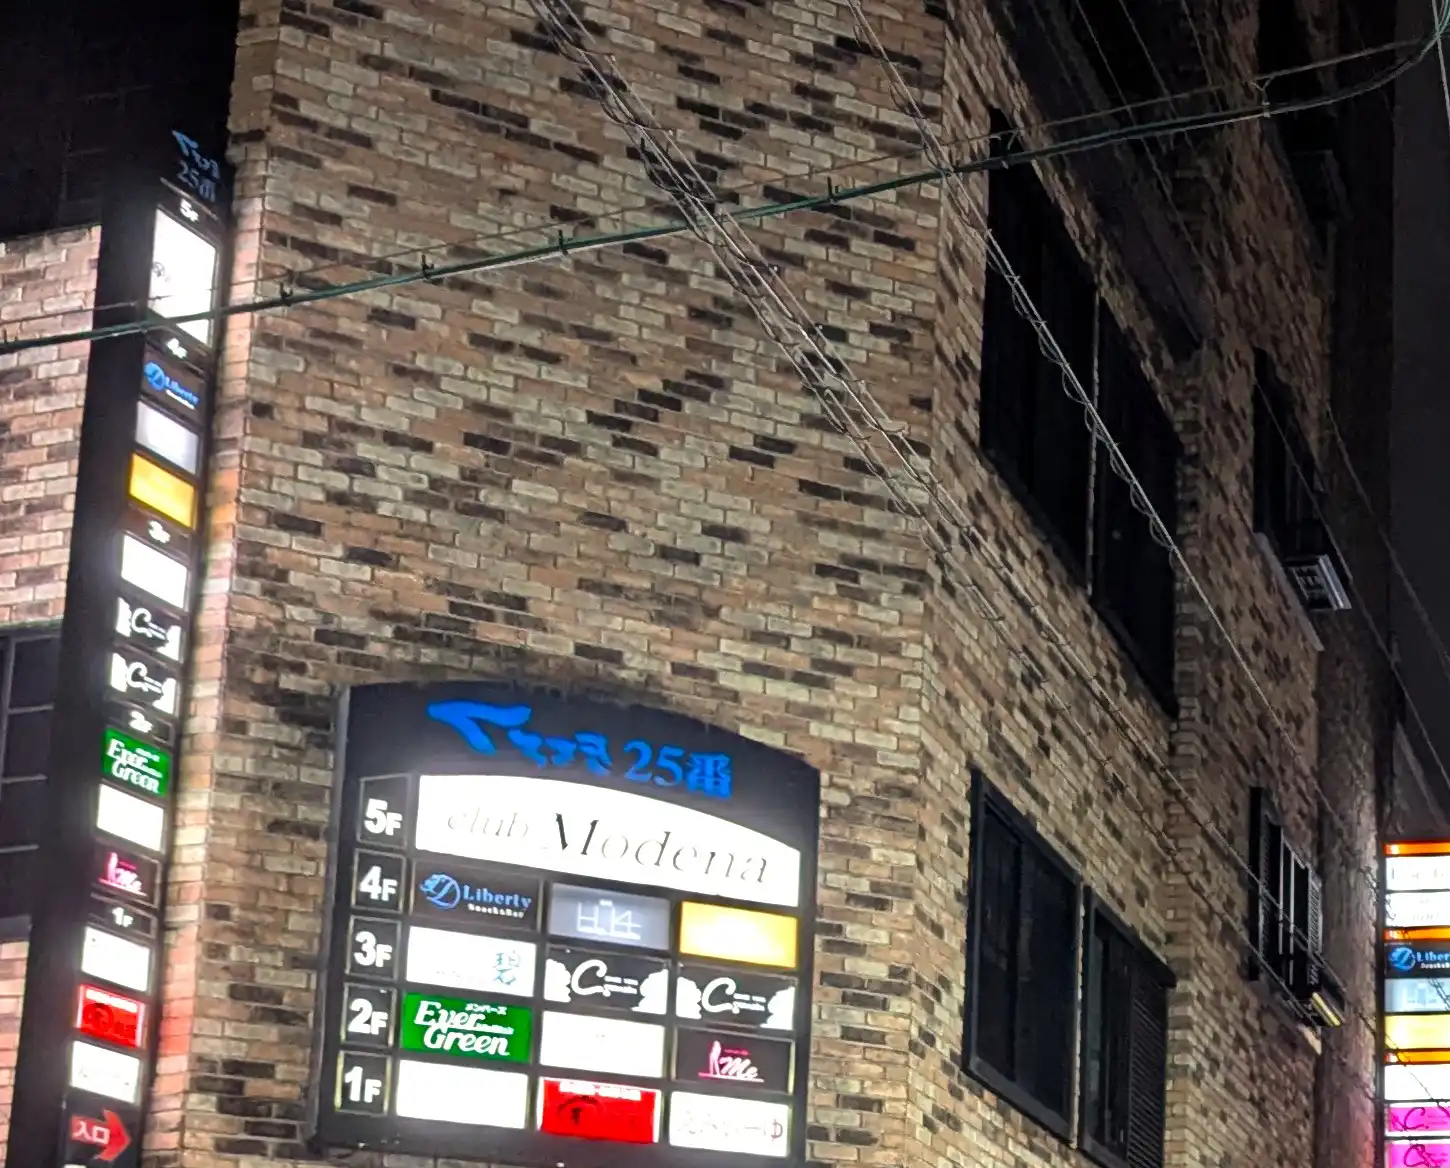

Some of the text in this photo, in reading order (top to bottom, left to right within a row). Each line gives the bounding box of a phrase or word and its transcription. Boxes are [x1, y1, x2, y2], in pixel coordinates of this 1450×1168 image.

[363, 798, 402, 836] 5F
[545, 811, 769, 885] Modena
[359, 865, 398, 902] 4F
[462, 884, 532, 909] Liberty
[353, 931, 393, 968] 3F
[348, 999, 388, 1035] 2F
[414, 1000, 486, 1033] Ever
[423, 1024, 511, 1057] Green
[344, 1066, 383, 1104] 1F
[72, 1119, 110, 1145] 入口
